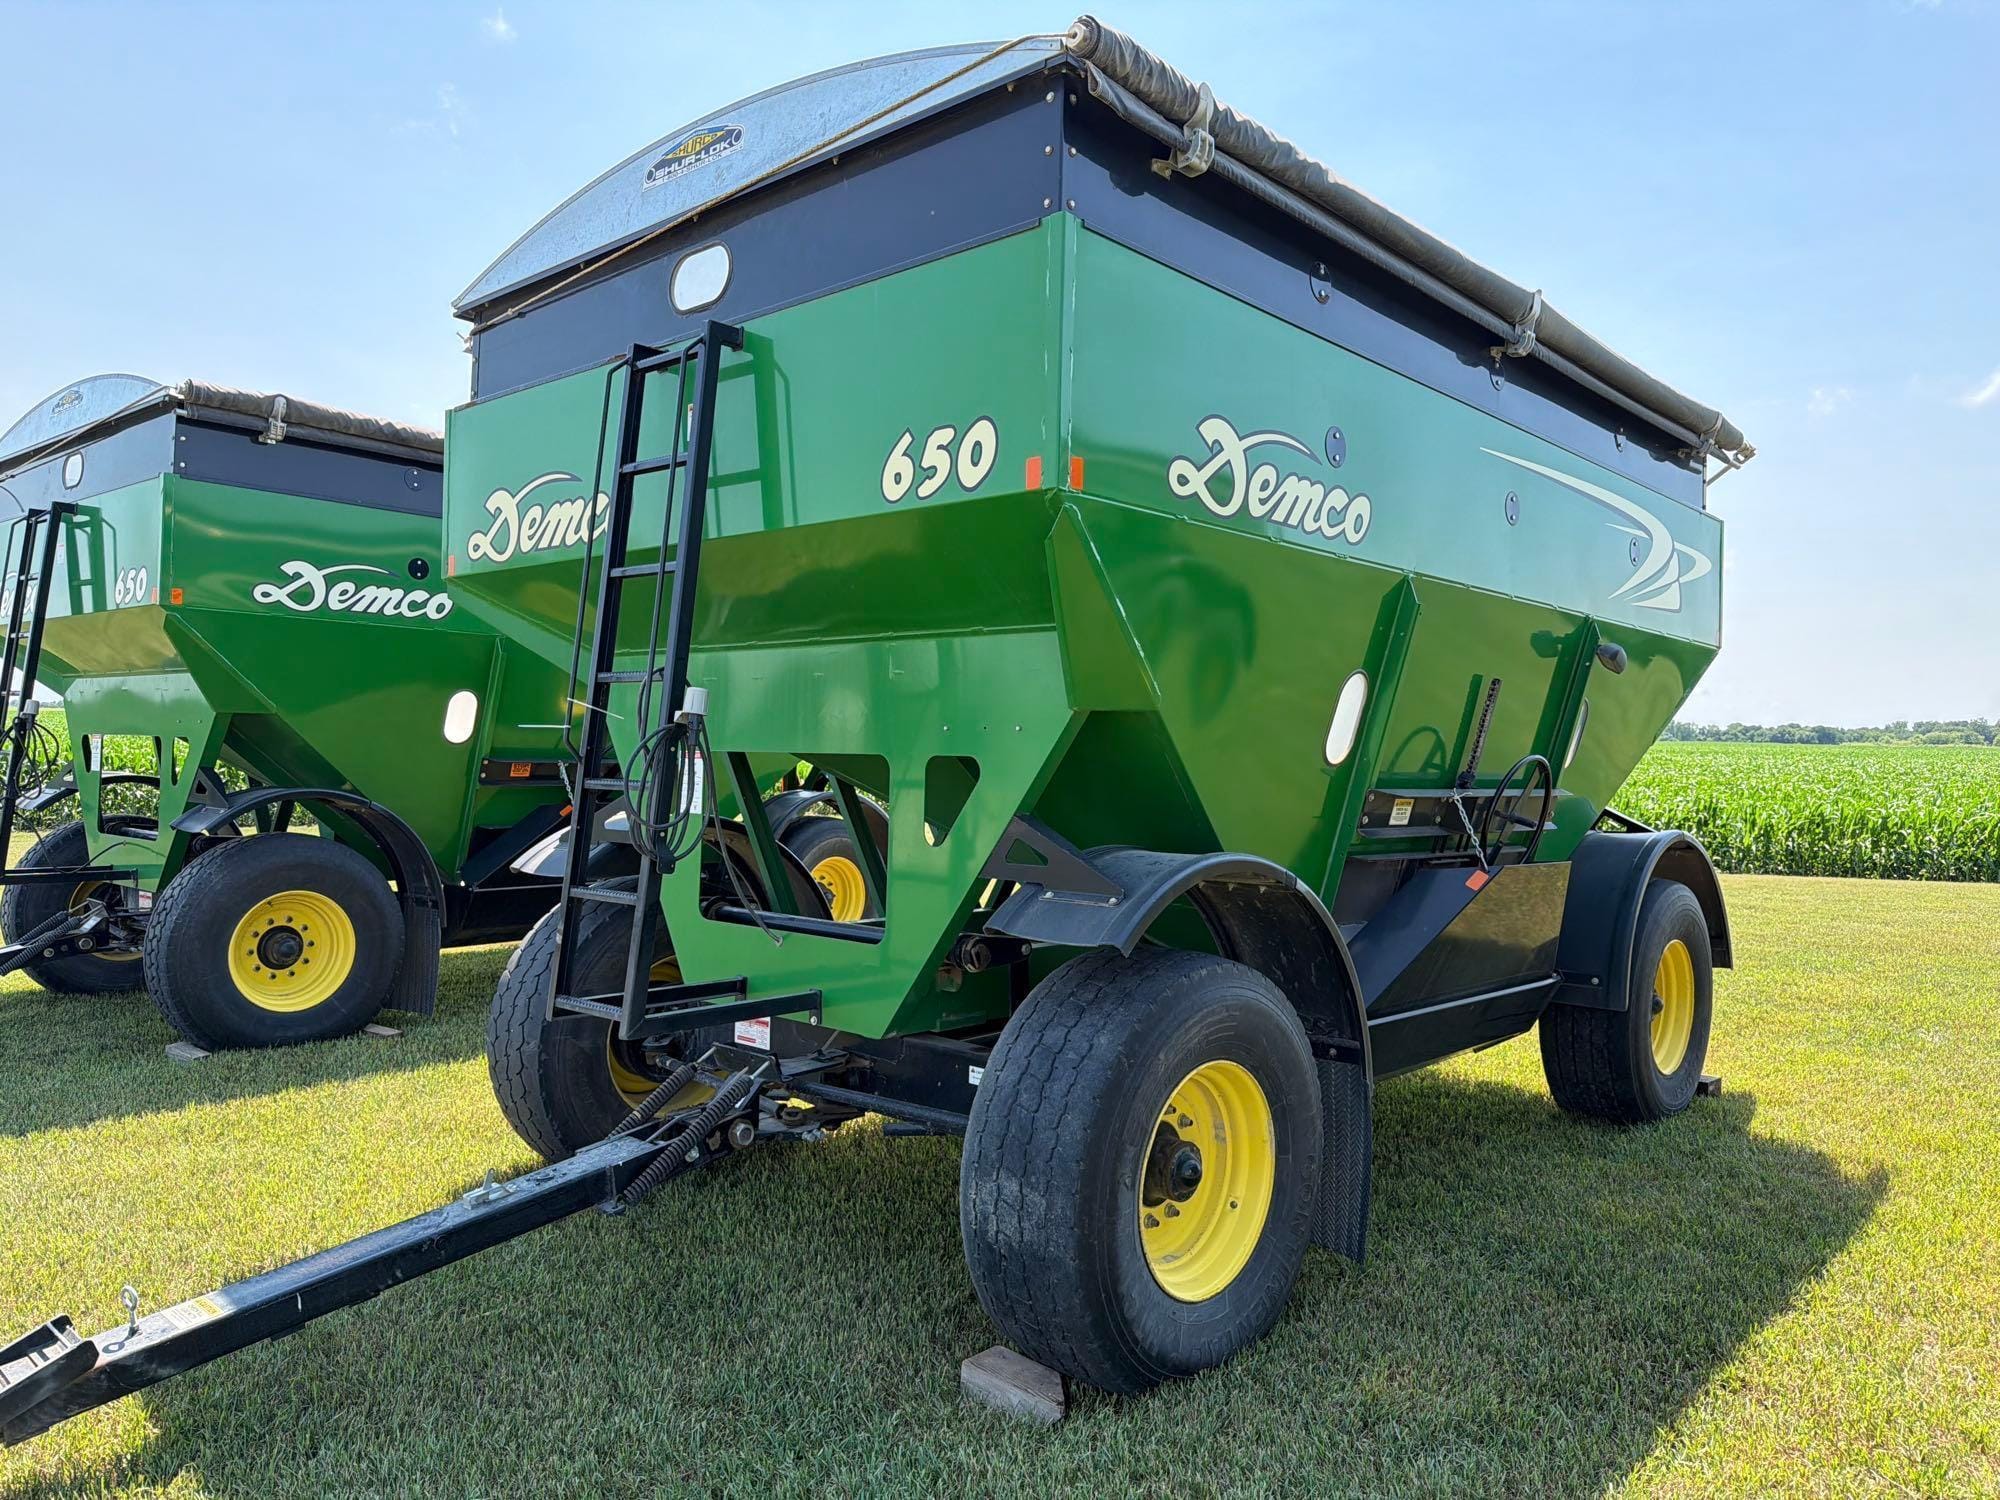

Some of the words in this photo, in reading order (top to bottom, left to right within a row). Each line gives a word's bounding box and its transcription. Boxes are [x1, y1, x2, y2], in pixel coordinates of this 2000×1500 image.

[880, 415, 998, 504] 650
[1168, 413, 1371, 545] Demco
[467, 471, 612, 562] Demc
[114, 566, 147, 605] 650
[253, 560, 453, 620] Demco
